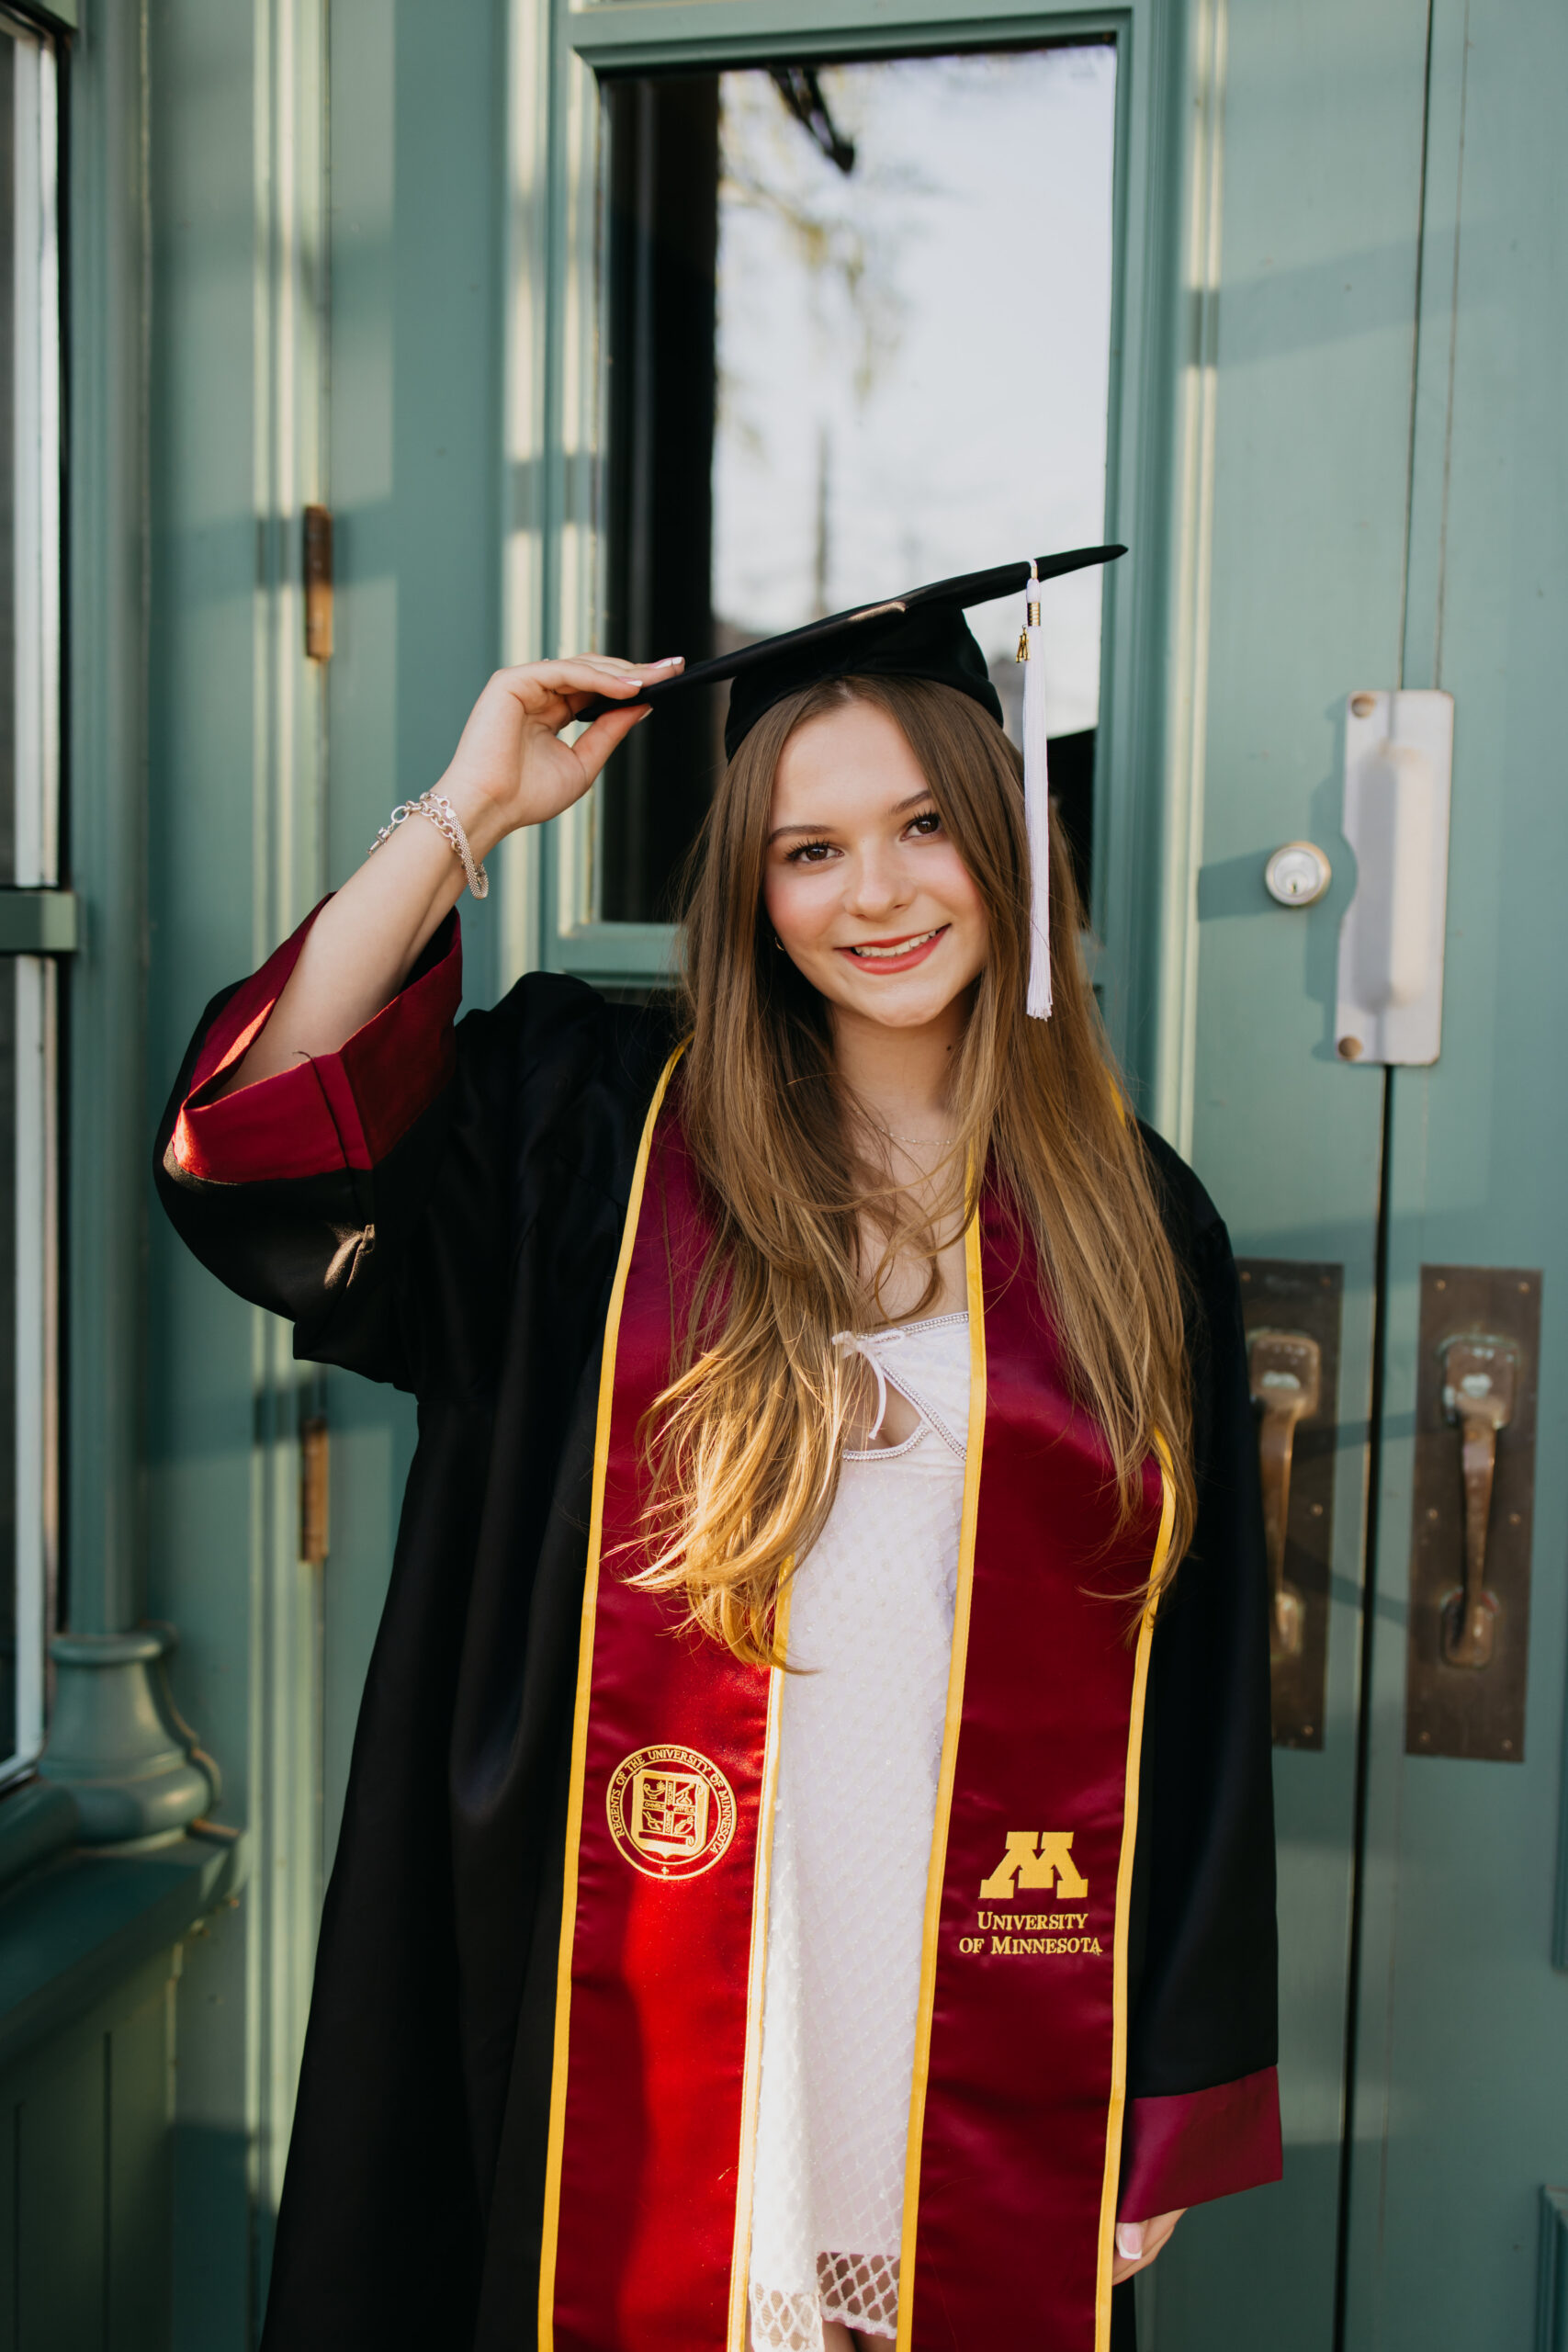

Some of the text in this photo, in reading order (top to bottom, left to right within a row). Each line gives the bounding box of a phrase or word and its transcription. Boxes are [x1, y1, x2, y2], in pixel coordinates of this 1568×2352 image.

[610, 1748, 733, 1854] REGENTS OF THE UNIVERSITY OF MINNESOTA
[977, 1911, 1089, 1930] UNIVERSITY
[990, 1936, 1103, 1955] MINNESOTA
